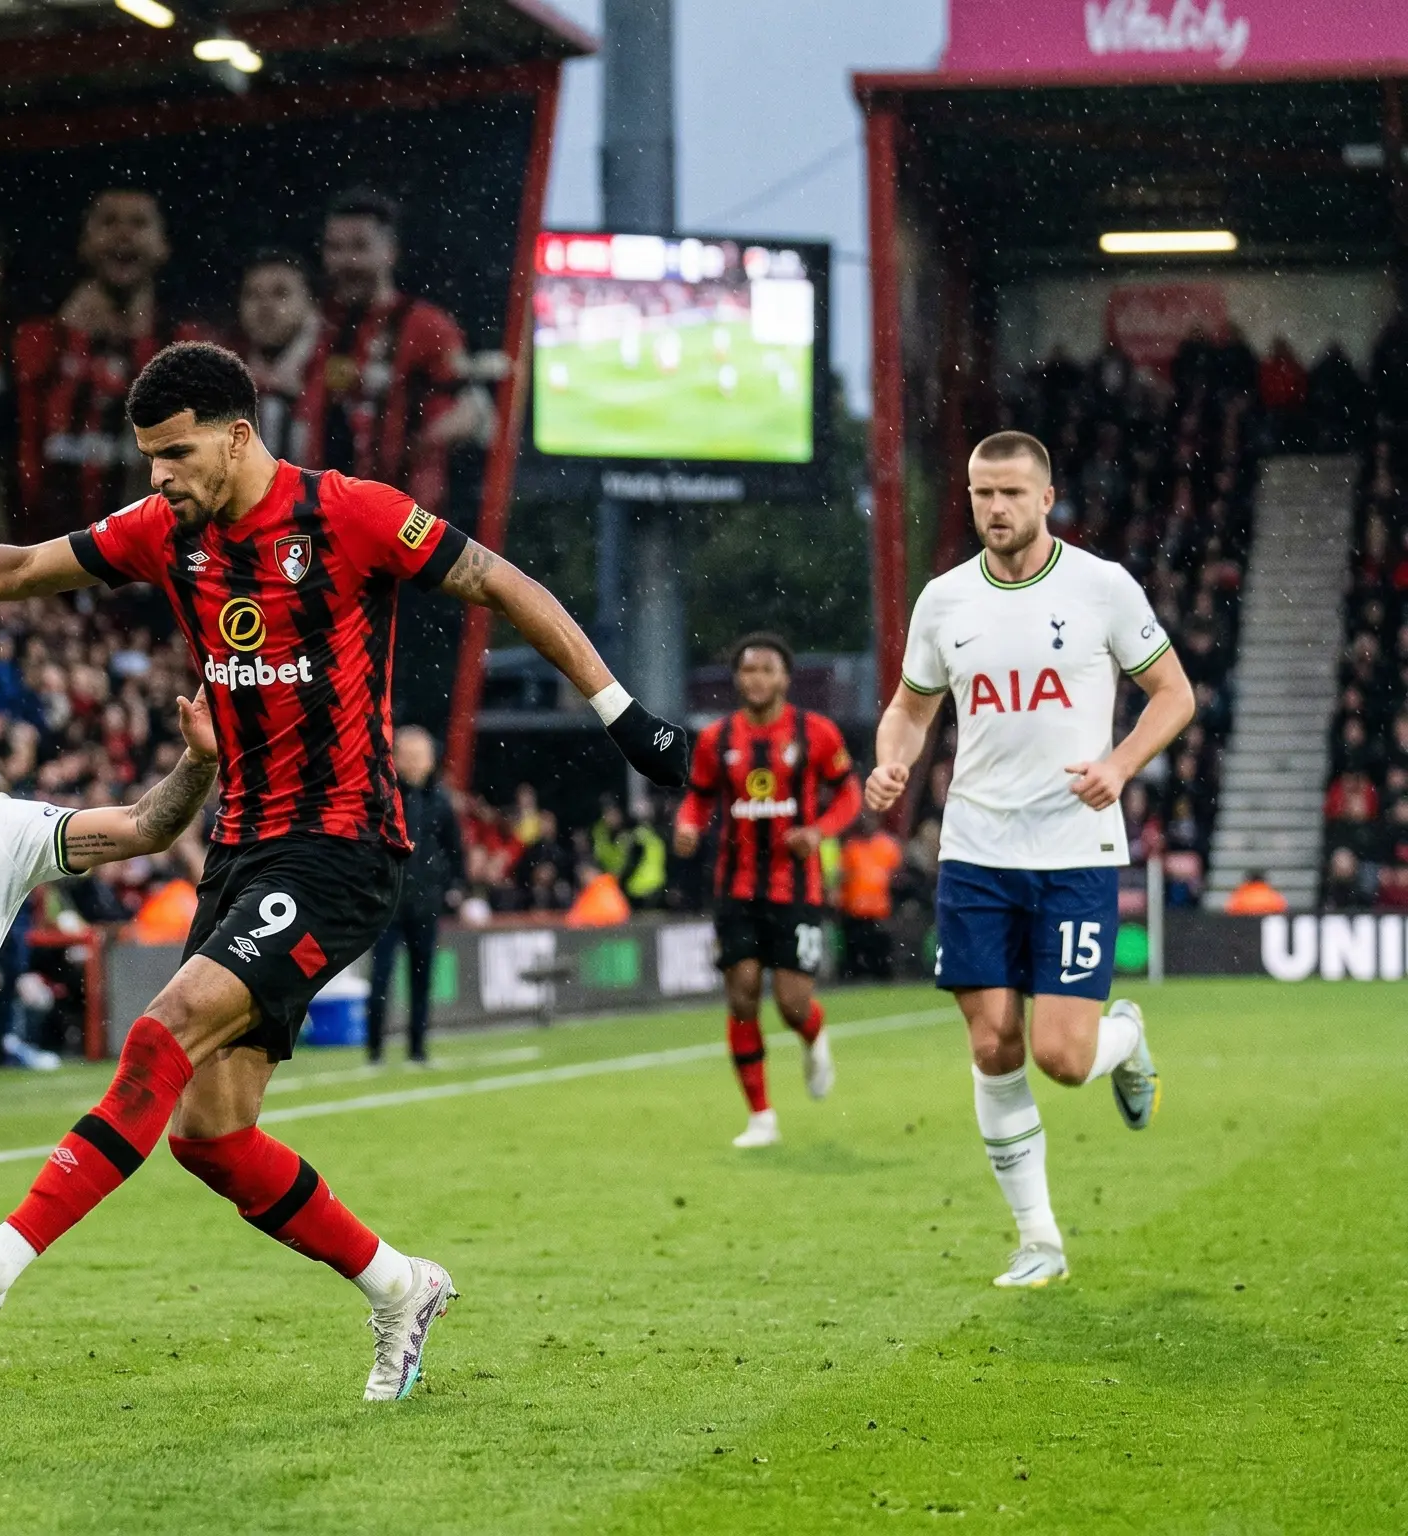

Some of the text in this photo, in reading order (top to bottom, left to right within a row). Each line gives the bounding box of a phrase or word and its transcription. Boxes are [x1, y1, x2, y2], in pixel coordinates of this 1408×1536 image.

[204, 654, 313, 692] dafabet
[969, 667, 1073, 716] AIA
[248, 892, 297, 939] 9
[1058, 920, 1102, 970] 15
[1259, 914, 1408, 982] UNI
